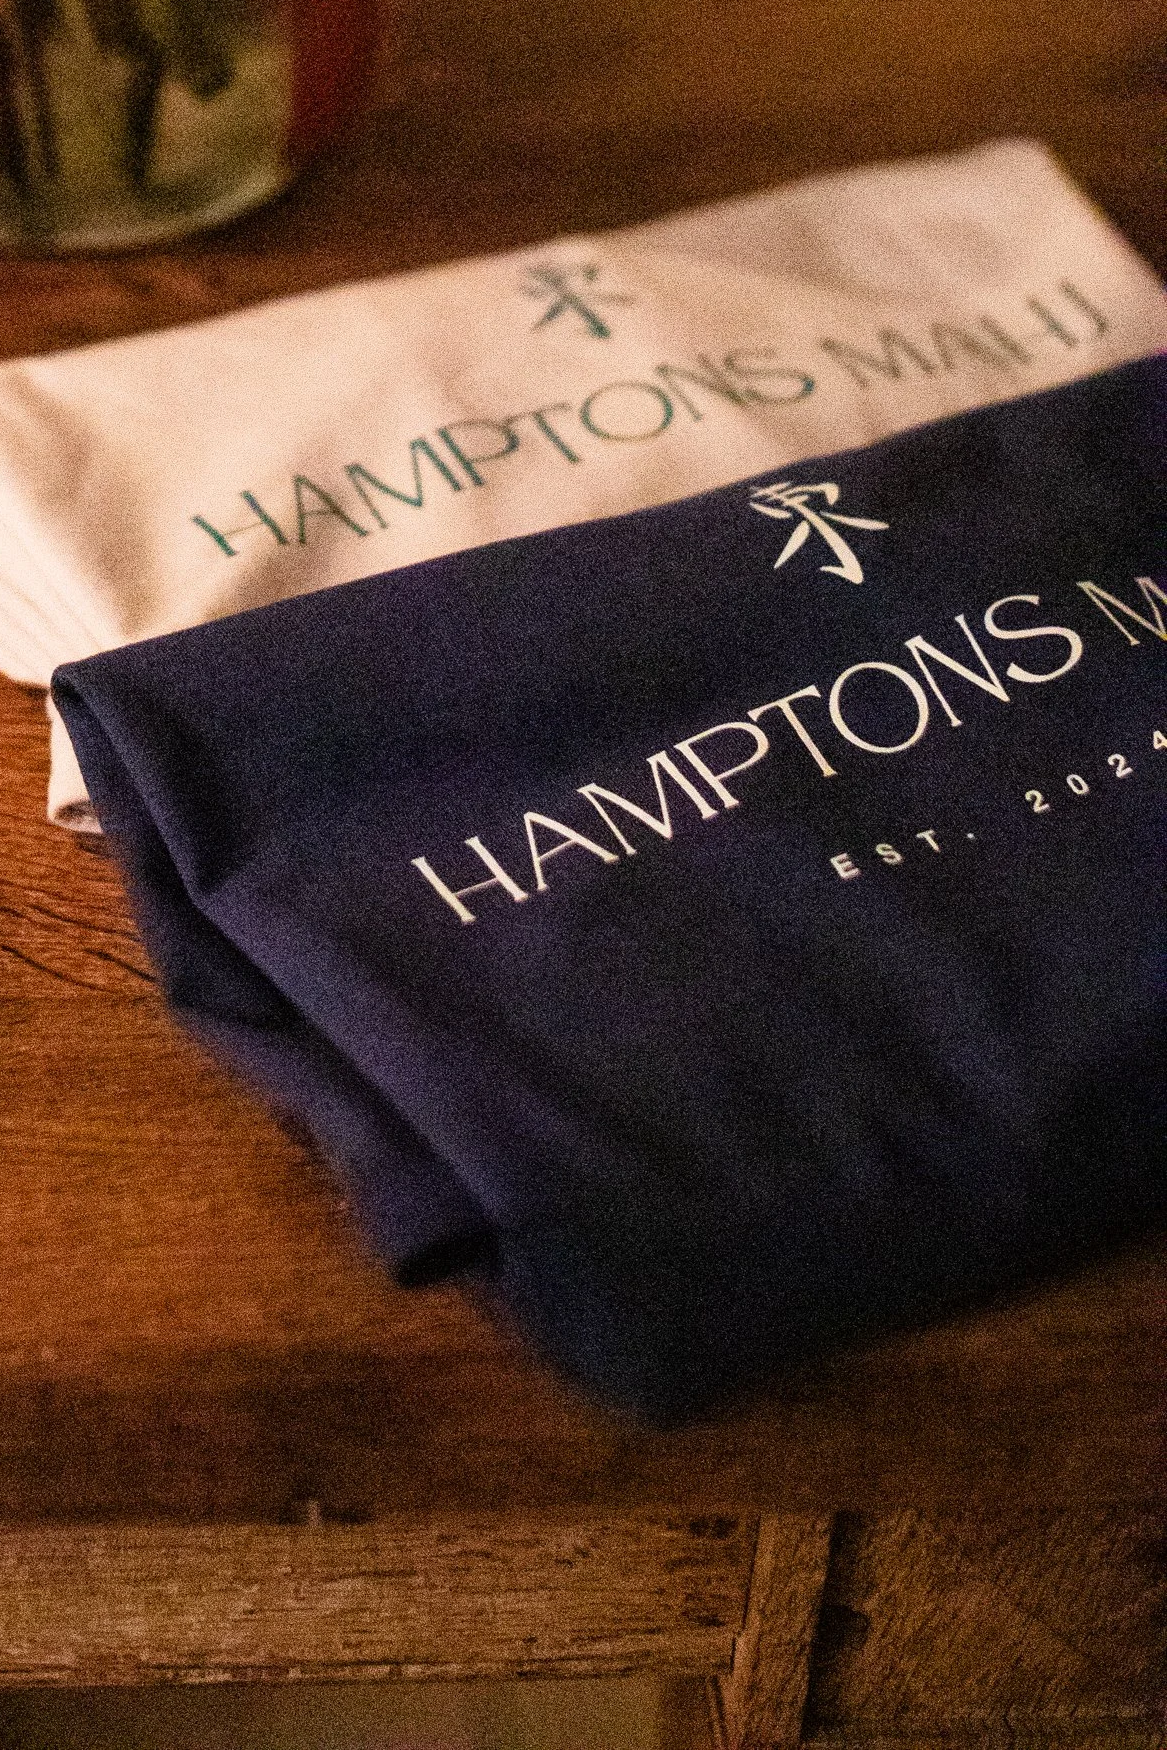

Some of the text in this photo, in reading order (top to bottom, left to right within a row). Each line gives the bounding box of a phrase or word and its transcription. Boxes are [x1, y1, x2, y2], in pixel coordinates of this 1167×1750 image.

[192, 278, 1113, 558] HAMPTONS MAHJ
[411, 594, 1083, 925] HAMPTONS
[830, 729, 1167, 880] EST. 2024
